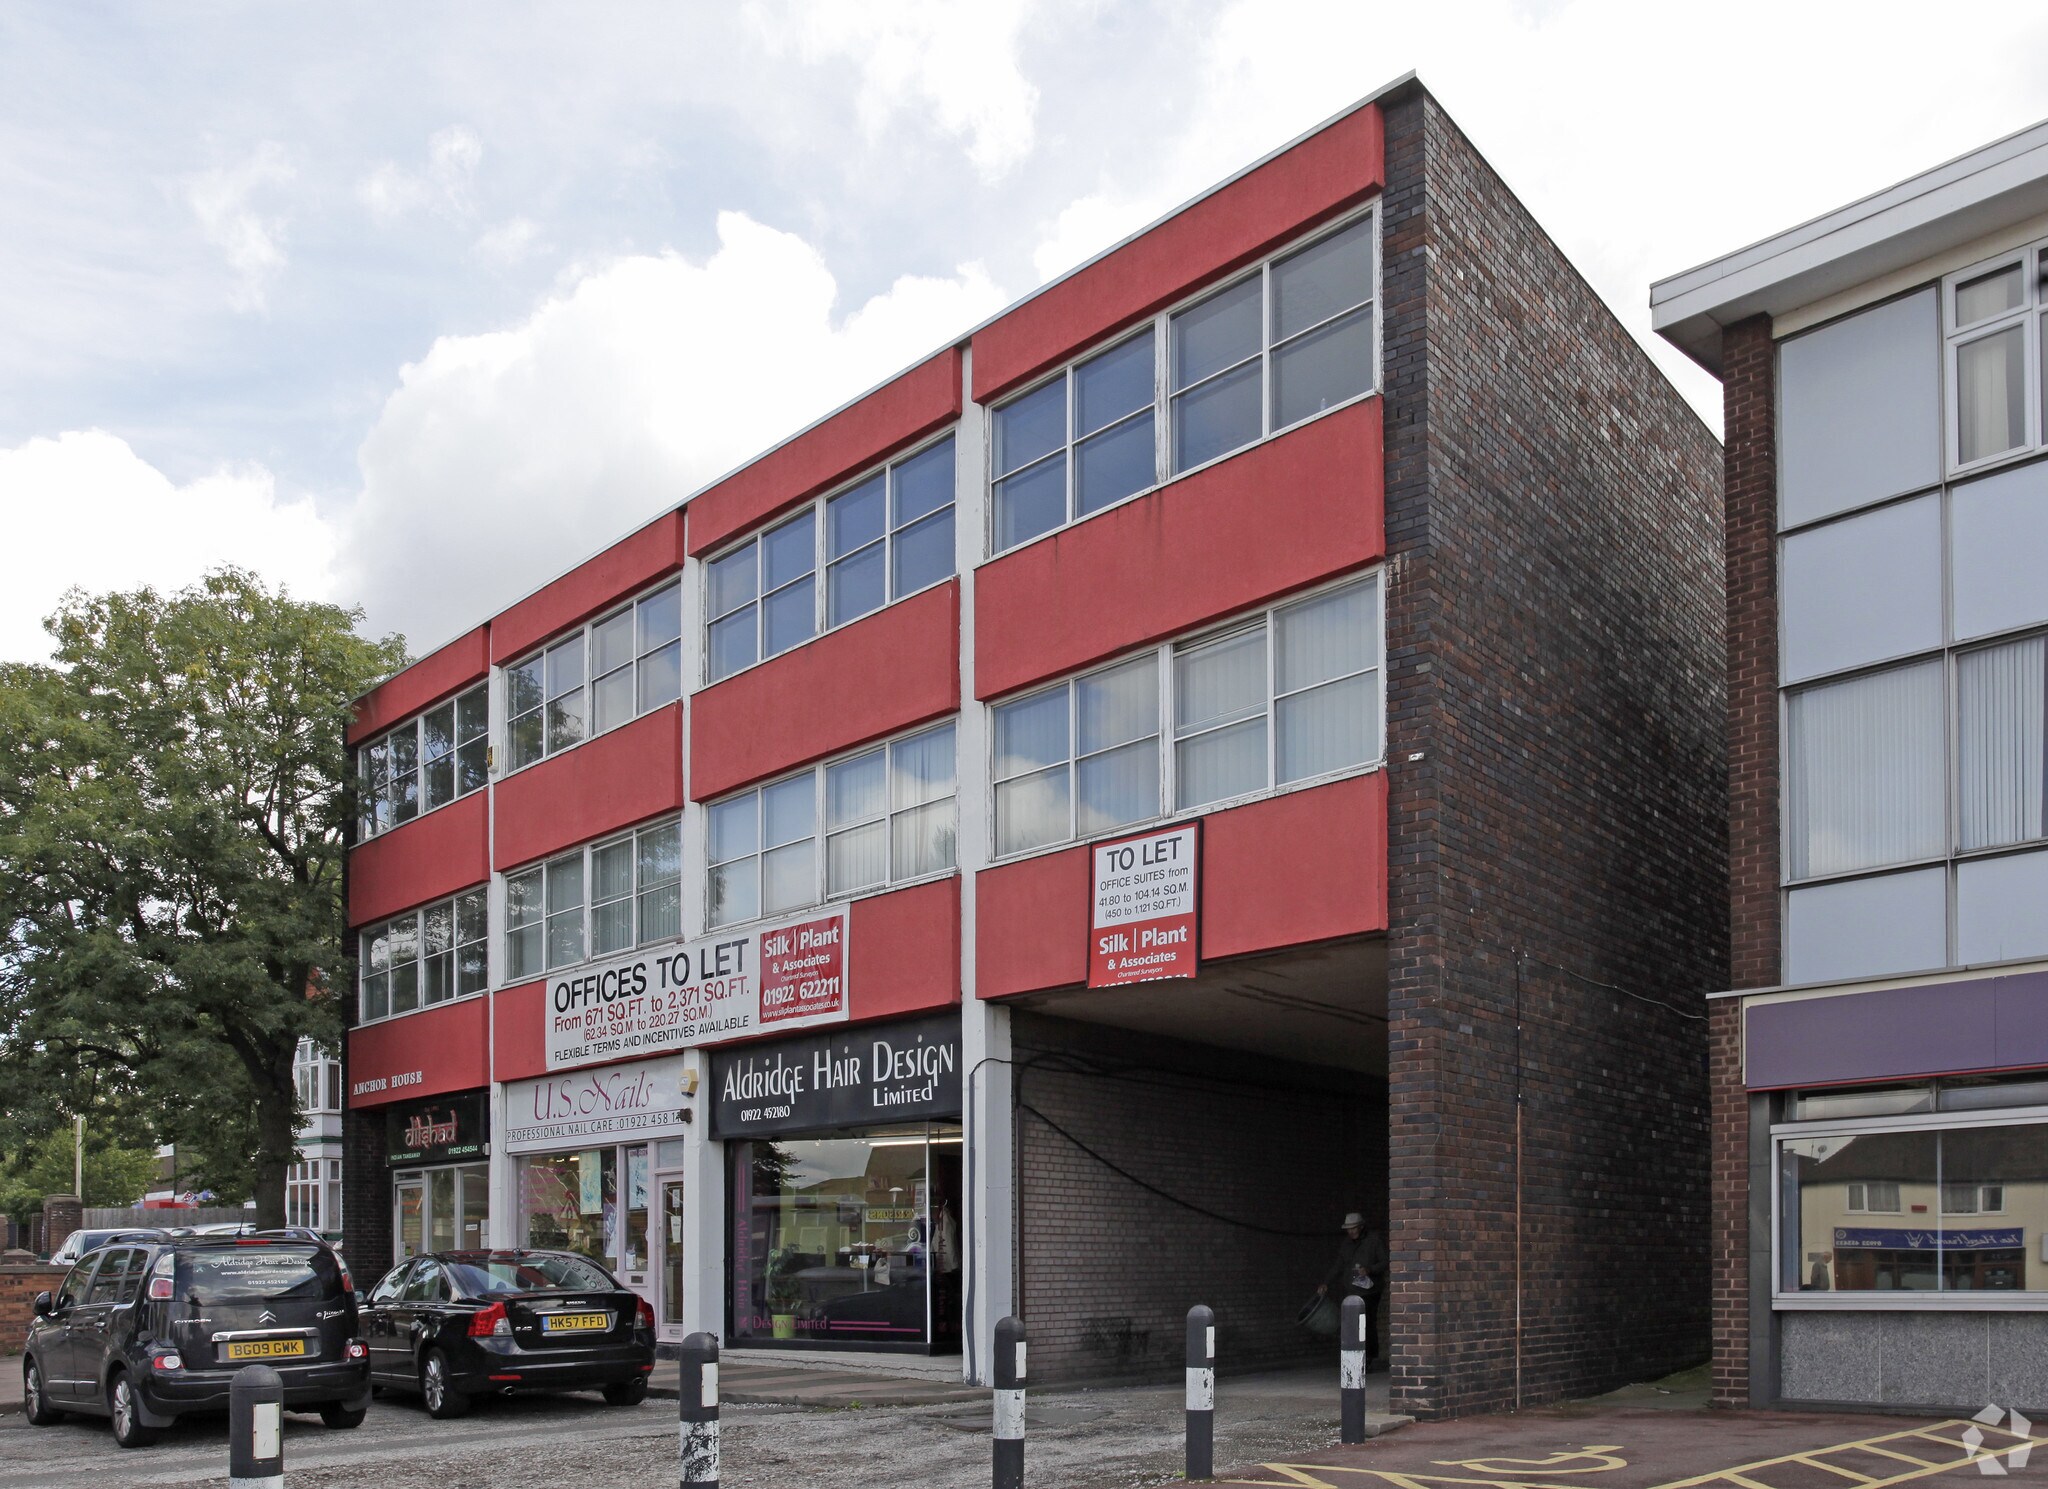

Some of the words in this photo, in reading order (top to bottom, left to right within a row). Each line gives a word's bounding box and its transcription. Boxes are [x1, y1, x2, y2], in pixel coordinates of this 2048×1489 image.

[1106, 846, 1135, 872] TO
[1142, 836, 1182, 866] LET
[1100, 876, 1131, 891] OFFICE
[1134, 869, 1165, 885] SUITES
[1168, 867, 1189, 878] from
[1099, 895, 1120, 907] 41.80
[1123, 893, 1131, 903] to
[1134, 887, 1160, 901] 104.14
[1163, 882, 1189, 896] SQ.M.
[1104, 908, 1121, 920] (450
[1124, 906, 1132, 915] to
[1134, 904, 1151, 915] 1,121
[765, 935, 790, 958] Silk
[800, 926, 839, 950] Plant
[1099, 933, 1129, 955] Silk
[1141, 925, 1188, 948] Plant
[772, 962, 779, 973] &
[782, 953, 830, 971] Associates
[1107, 958, 1116, 970] &
[1119, 951, 1177, 969] Associates
[1117, 968, 1140, 978] Chartered
[1140, 966, 1163, 976] Surveyors
[555, 962, 647, 1013] OFFICES
[656, 952, 690, 988] TO
[700, 938, 749, 980] LET
[763, 984, 794, 1006] 01922
[800, 976, 839, 1000] 622211
[554, 1014, 582, 1033] From
[585, 1007, 603, 1027] 671
[607, 998, 647, 1021] SQ.FT.
[650, 995, 663, 1012] to
[668, 986, 700, 1011] 2,371
[704, 976, 749, 1001] SQ.FT.
[637, 1018, 647, 1030] to
[649, 1011, 679, 1028] 220.27
[555, 1042, 590, 1061] FLEXIBLE
[593, 1040, 621, 1054] TERMS
[623, 1034, 641, 1047] AND
[642, 1025, 695, 1045] INCENTIVES
[698, 1015, 749, 1036] AVAILABLE
[353, 1078, 387, 1096] ANCHOR
[391, 1071, 423, 1088] HOUSE
[740, 1106, 761, 1122] 01922
[763, 1105, 790, 1120] 452180
[405, 1109, 458, 1149] dilshad
[507, 1124, 565, 1141] PROFESSIONAL
[568, 1123, 587, 1135] NAIL
[591, 1120, 613, 1133] CARE
[651, 1113, 668, 1125] 458
[210, 1255, 253, 1269] Aldridge
[255, 1255, 278, 1266] Hair
[281, 1256, 311, 1267] Design
[550, 1317, 579, 1329] HK57
[582, 1316, 604, 1326] FFD
[233, 1343, 270, 1356] BG09
[273, 1342, 299, 1354] GWK
